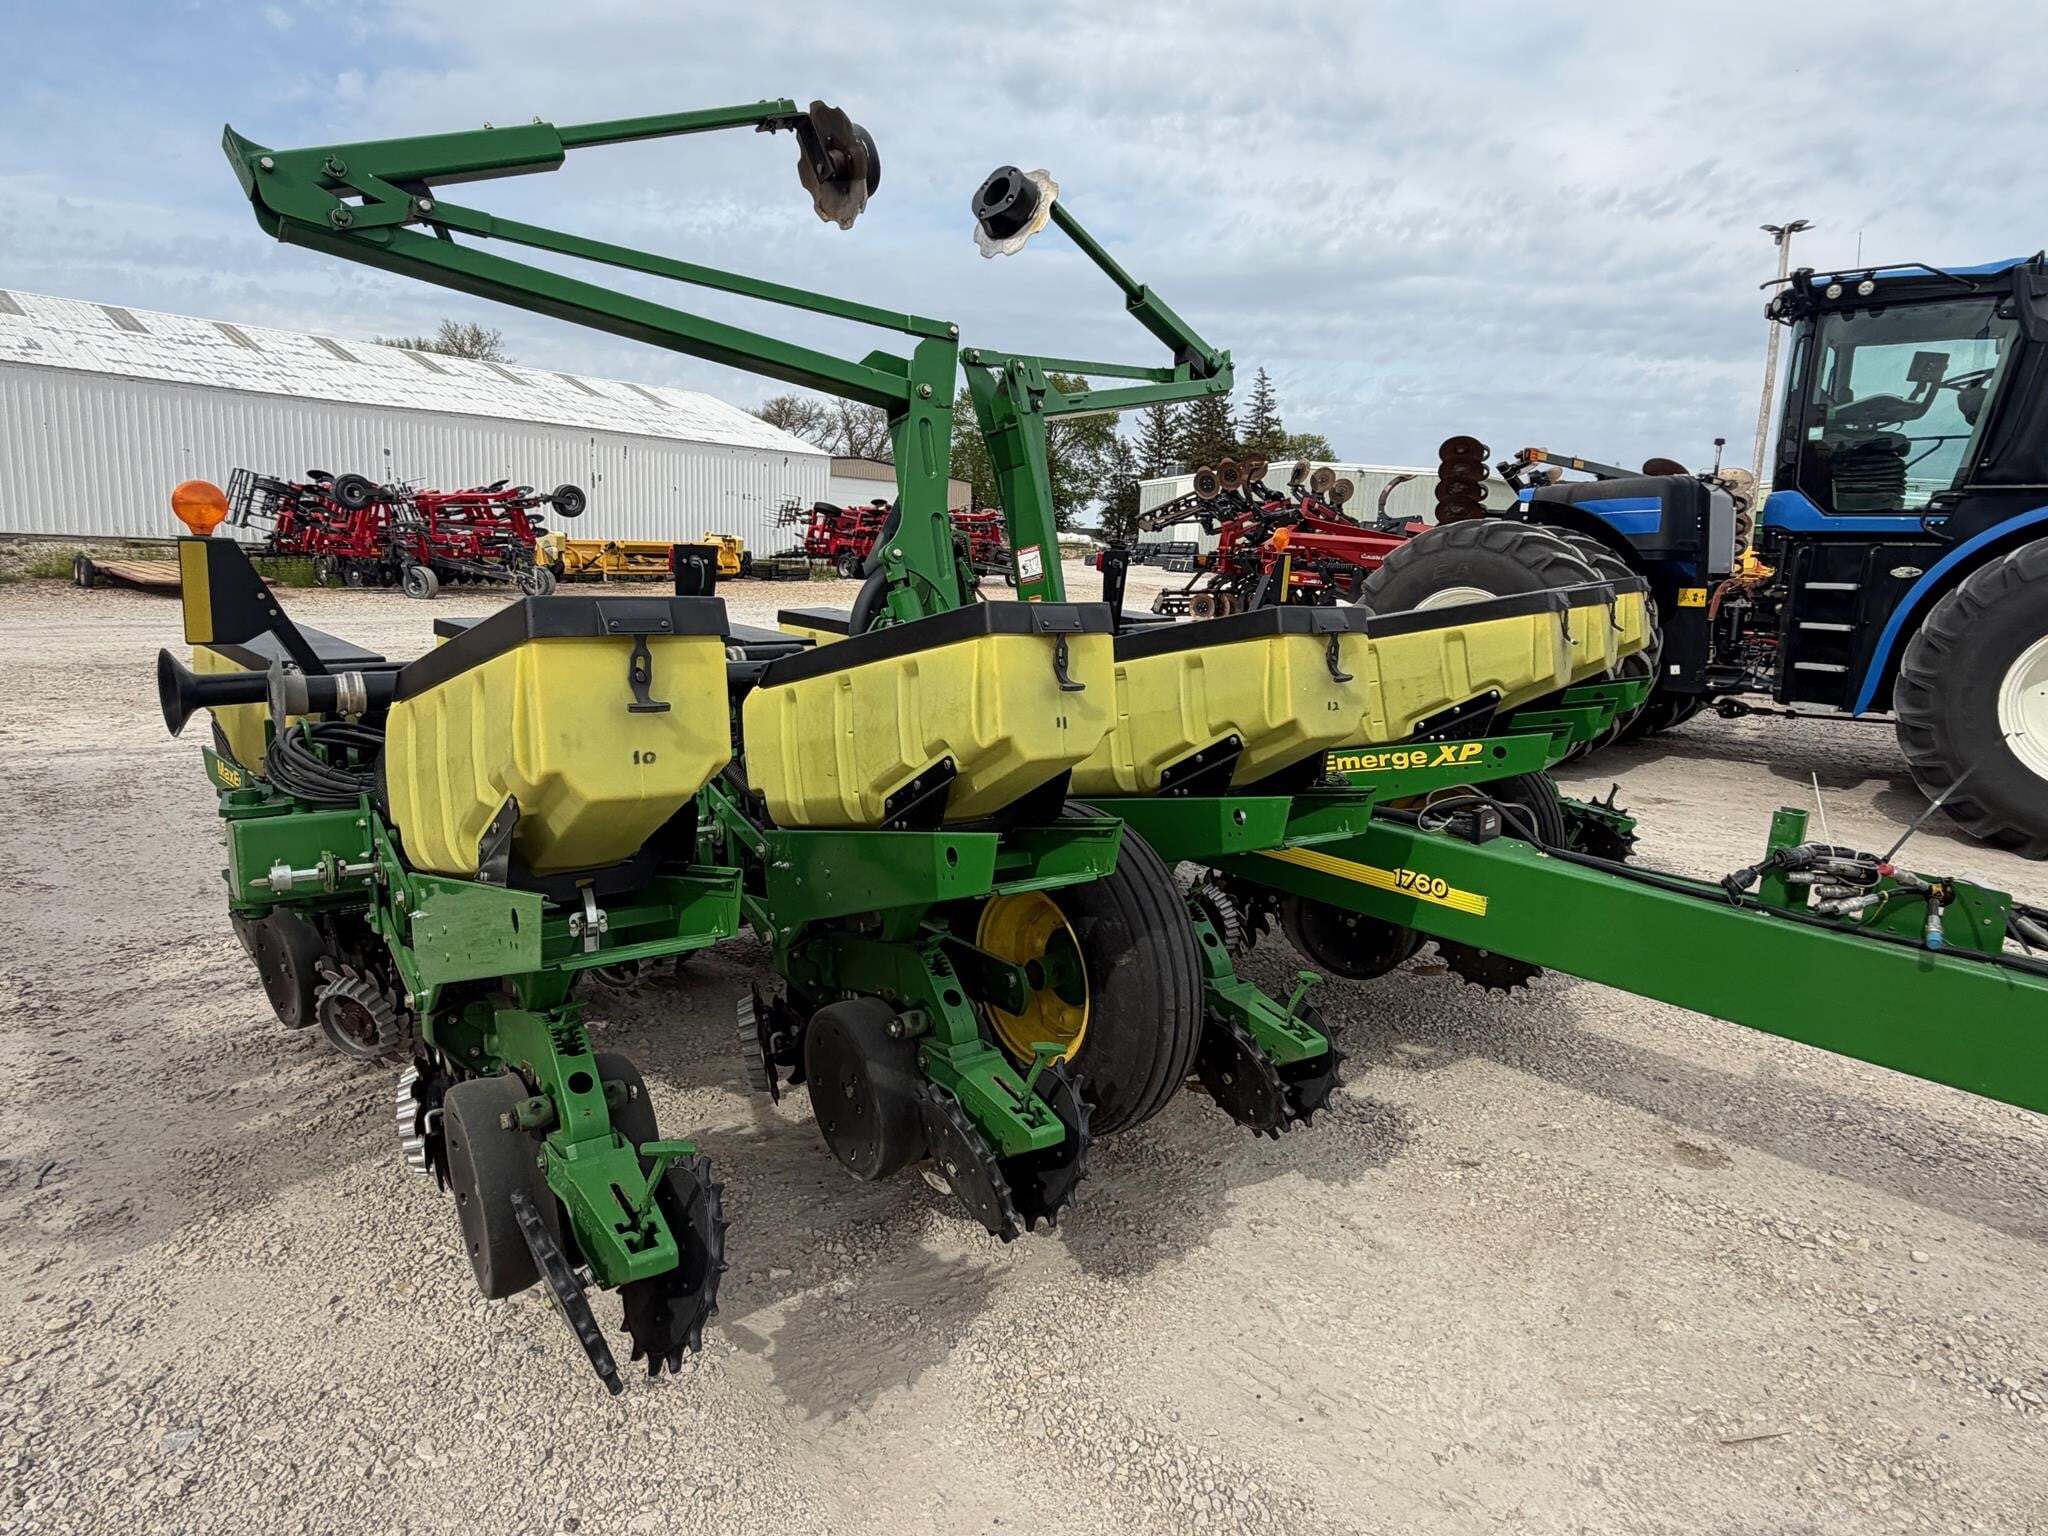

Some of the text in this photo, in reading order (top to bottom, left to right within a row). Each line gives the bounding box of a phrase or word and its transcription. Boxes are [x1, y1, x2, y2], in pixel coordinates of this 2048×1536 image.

[633, 750, 657, 765] 10
[1429, 743, 1483, 767] XP
[1393, 867, 1449, 899] 1760
